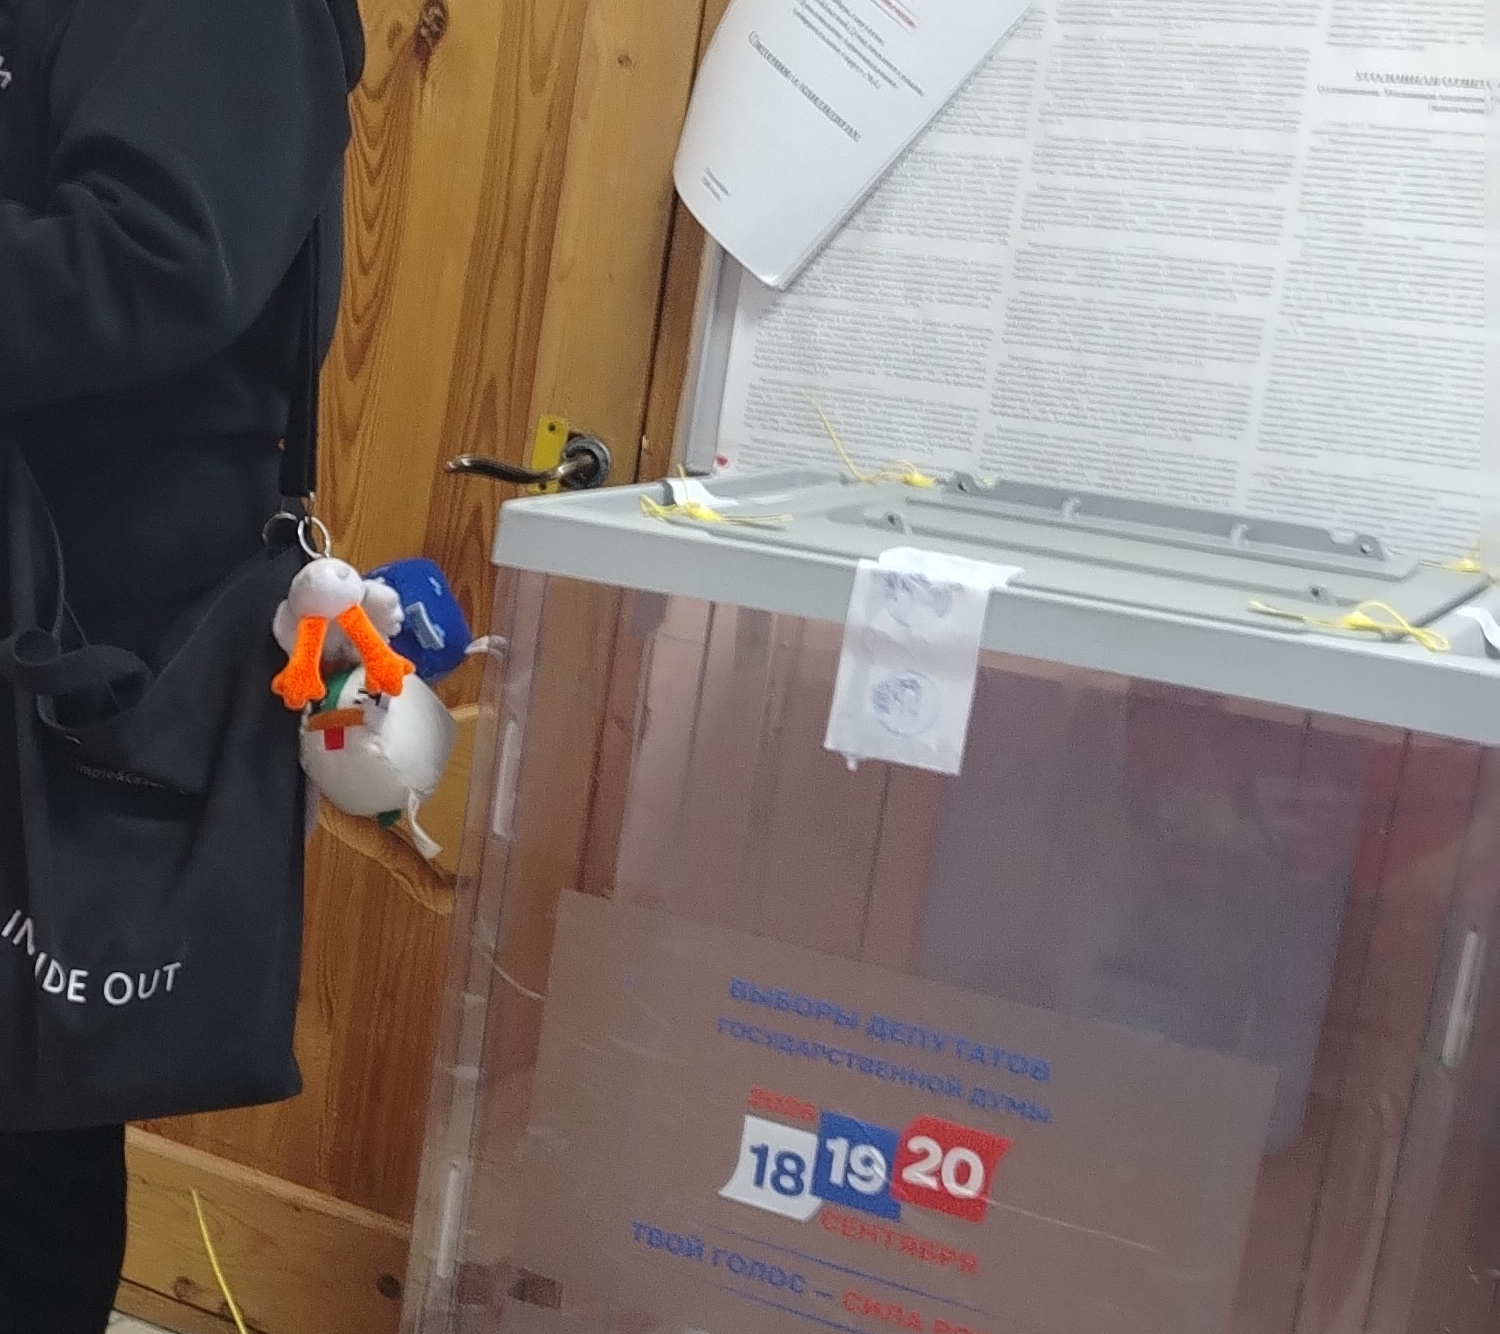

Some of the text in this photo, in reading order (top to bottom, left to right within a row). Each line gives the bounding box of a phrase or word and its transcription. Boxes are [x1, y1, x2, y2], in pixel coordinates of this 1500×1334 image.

[1, 909, 182, 1006] INIDE OUT
[717, 1017, 1052, 1123] ГОСУДАРСТВЕННОЙ ДУМЫ
[729, 977, 1052, 1082] ВЫБОРЫ ДЕПУТАТОВ
[750, 1135, 985, 1199] 18 19 20
[631, 1220, 705, 1261] ТВОЙ
[711, 1247, 807, 1295] ГОЛОС
[841, 1290, 923, 1333] СИЛА
[819, 1208, 980, 1275] СЕНТЯБРЯ
